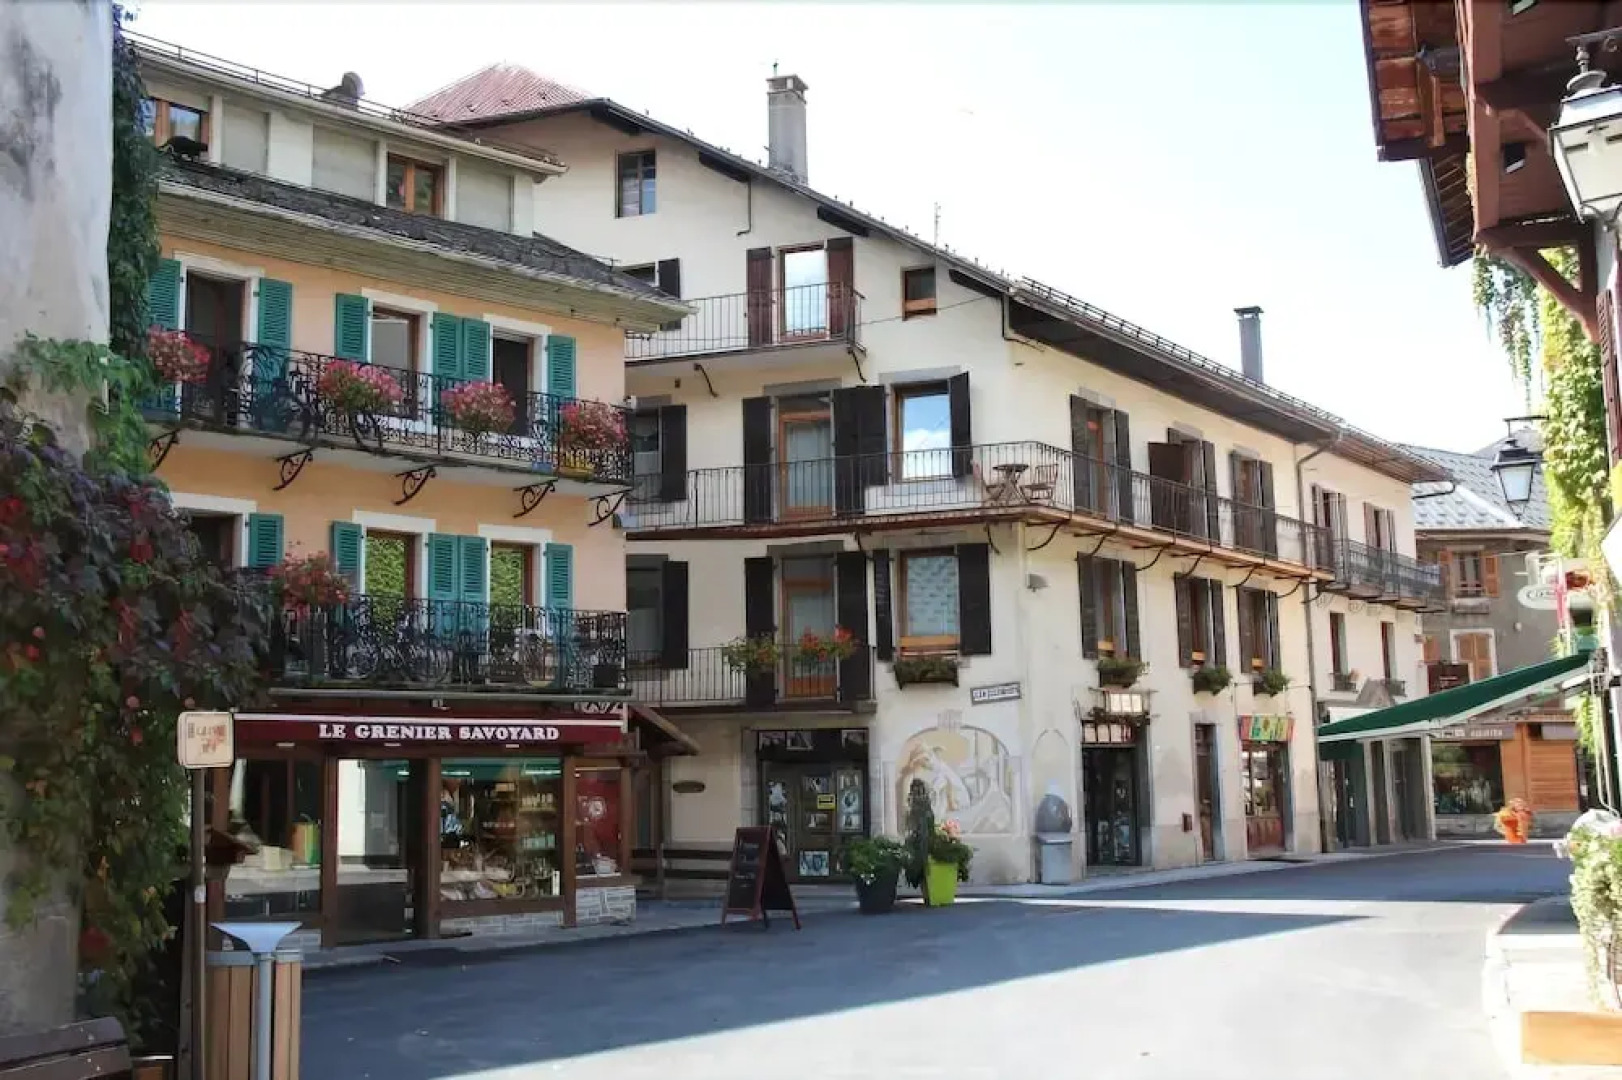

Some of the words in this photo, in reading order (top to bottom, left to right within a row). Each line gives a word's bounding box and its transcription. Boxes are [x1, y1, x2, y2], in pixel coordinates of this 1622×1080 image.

[319, 724, 346, 738] LE
[355, 725, 451, 740] GRENIER
[459, 726, 559, 740] SAVOYARD
